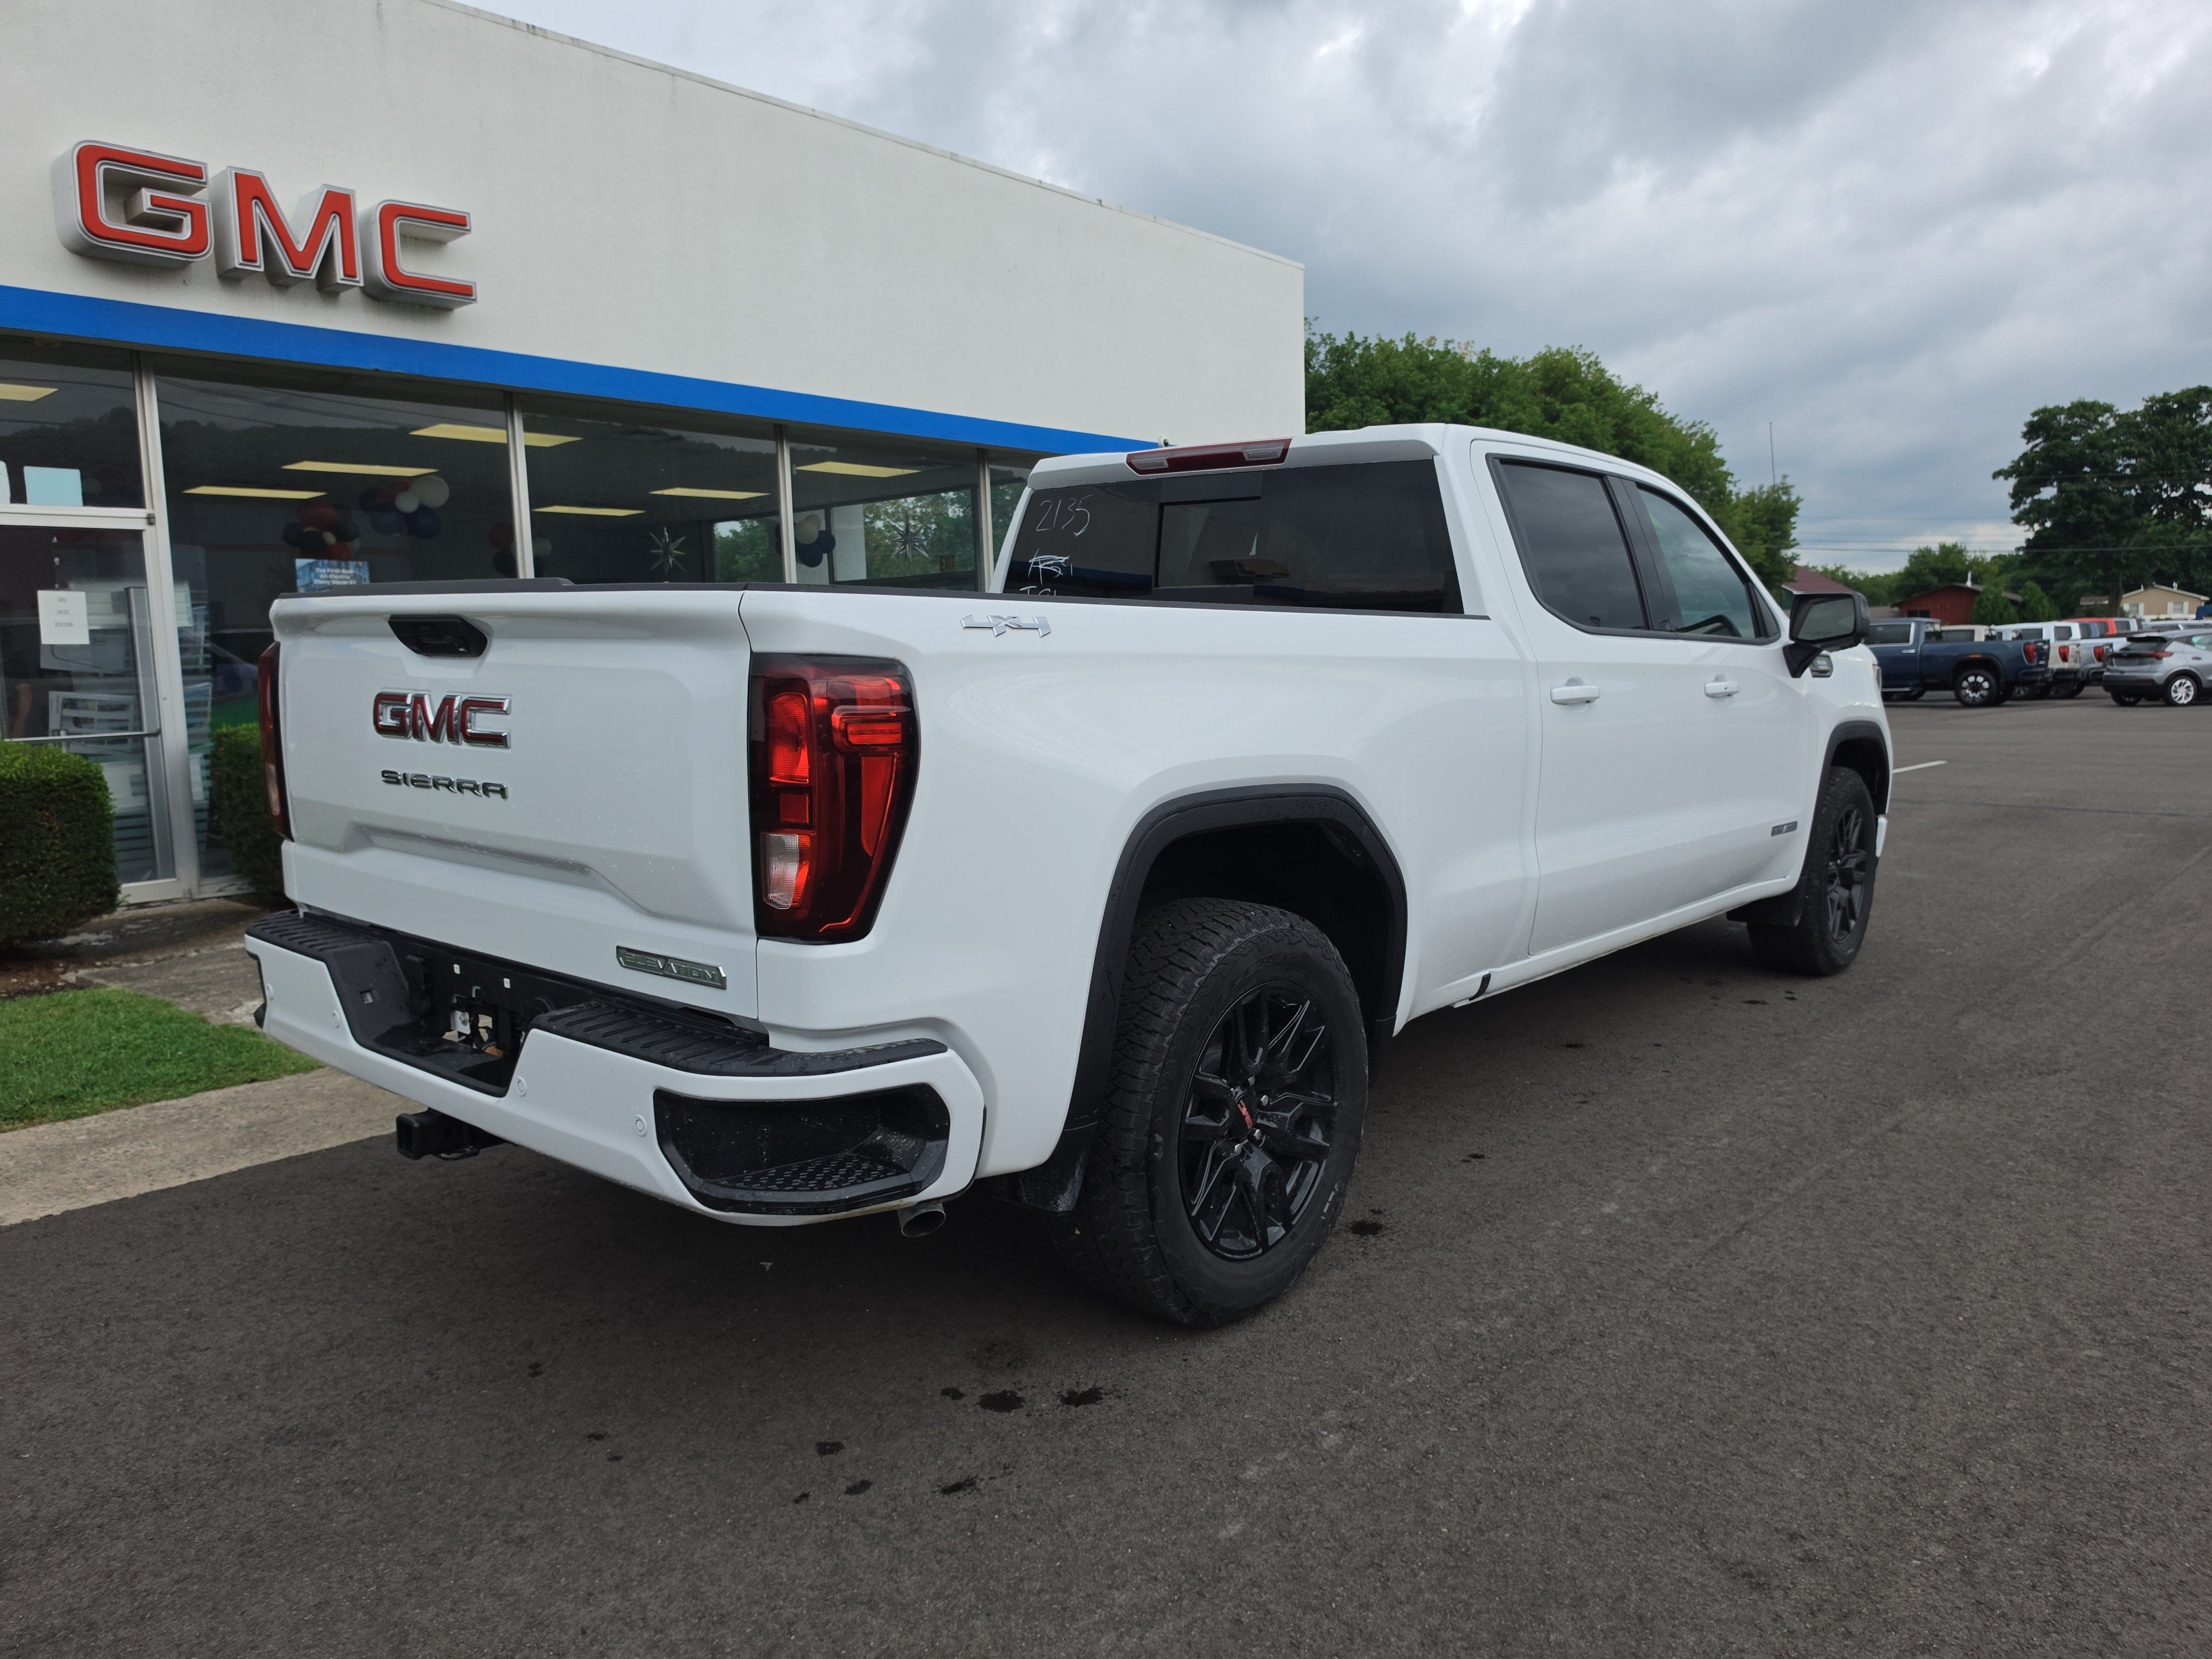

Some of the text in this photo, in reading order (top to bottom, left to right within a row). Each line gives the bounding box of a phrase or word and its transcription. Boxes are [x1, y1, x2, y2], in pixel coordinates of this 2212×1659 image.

[57, 140, 477, 308] GMC
[1036, 494, 1093, 537] 2135
[373, 691, 512, 749] GMC
[381, 769, 509, 801] SIERRA
